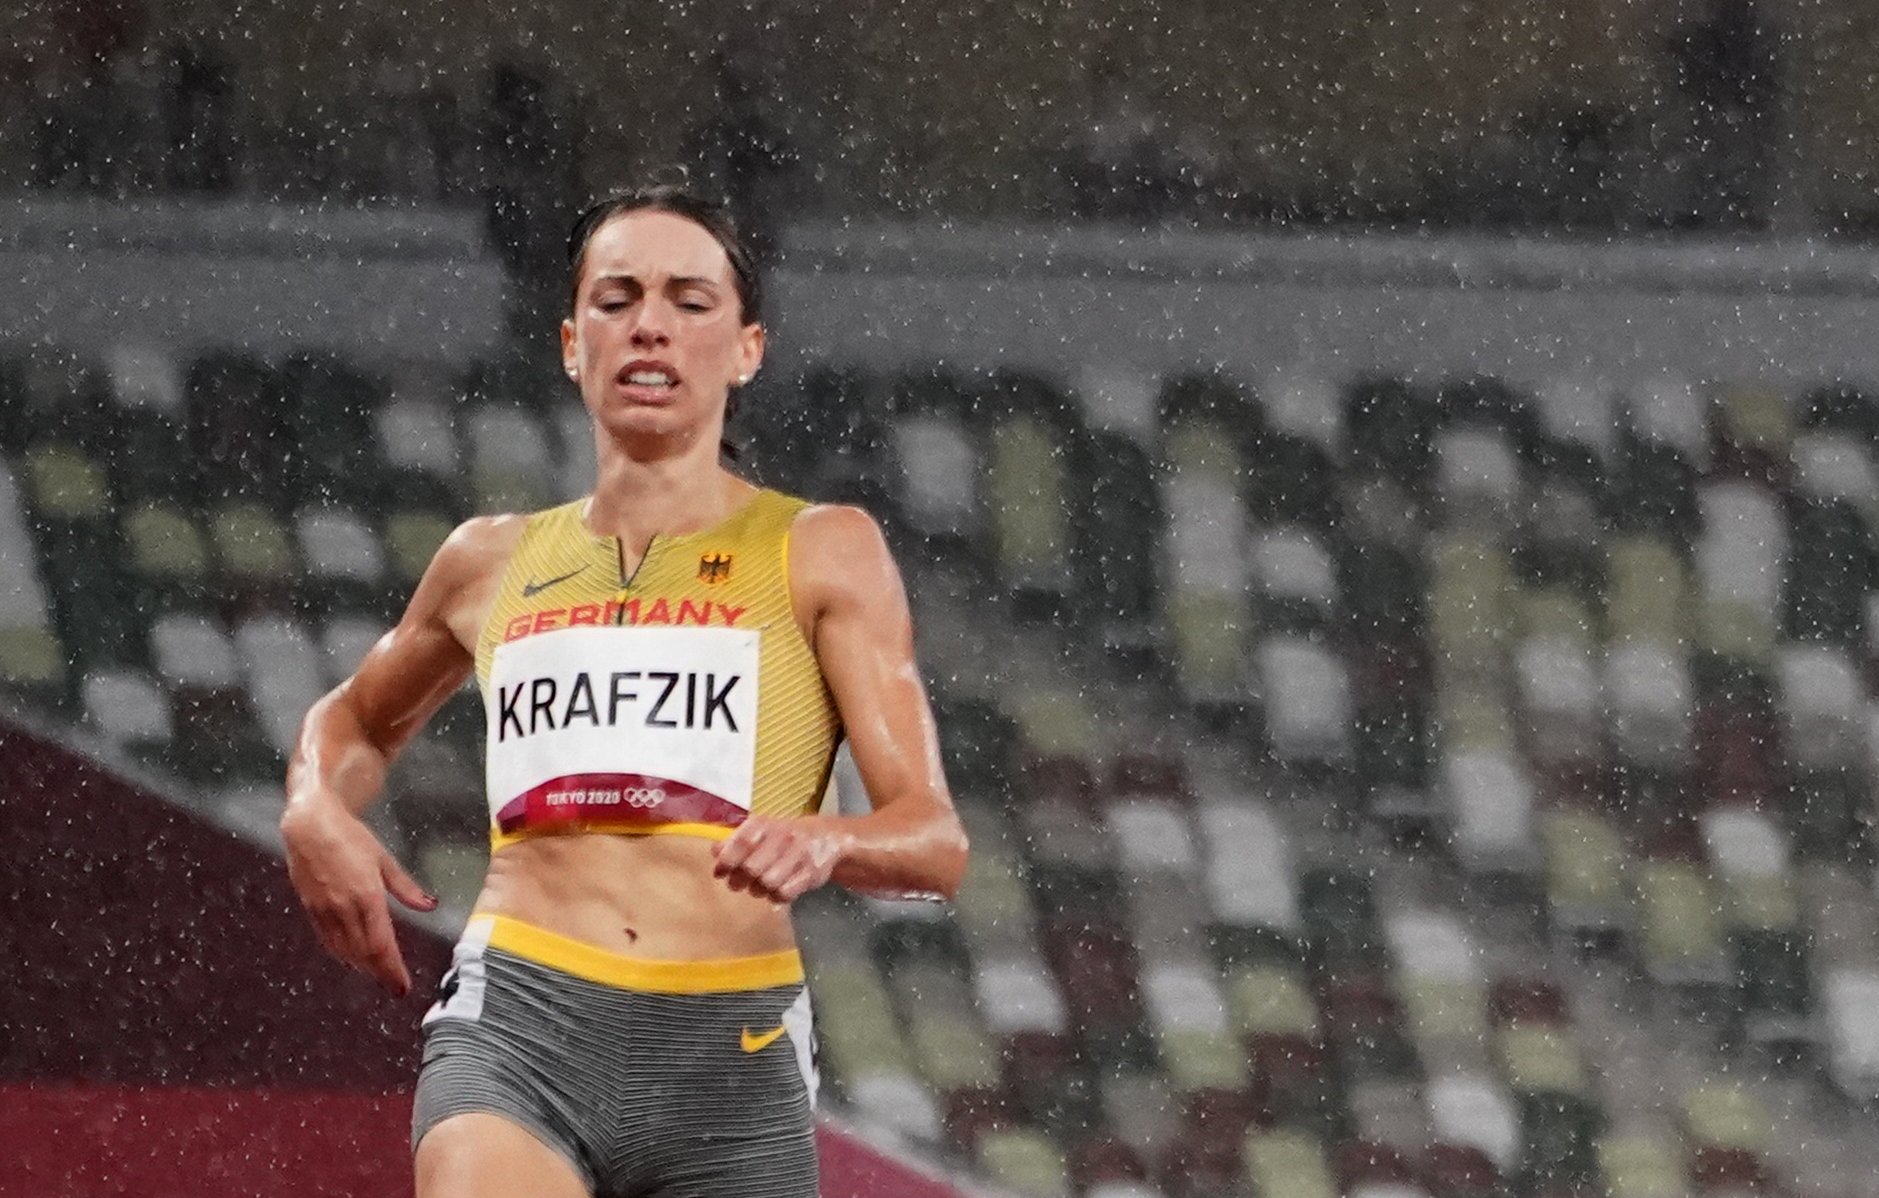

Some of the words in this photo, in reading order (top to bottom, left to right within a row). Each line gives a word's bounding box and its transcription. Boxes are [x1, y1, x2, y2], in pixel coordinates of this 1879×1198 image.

[504, 598, 746, 643] GERMANY
[498, 671, 742, 743] KRAFZIK
[546, 789, 586, 806] TOKYO
[587, 790, 621, 805] 2020
